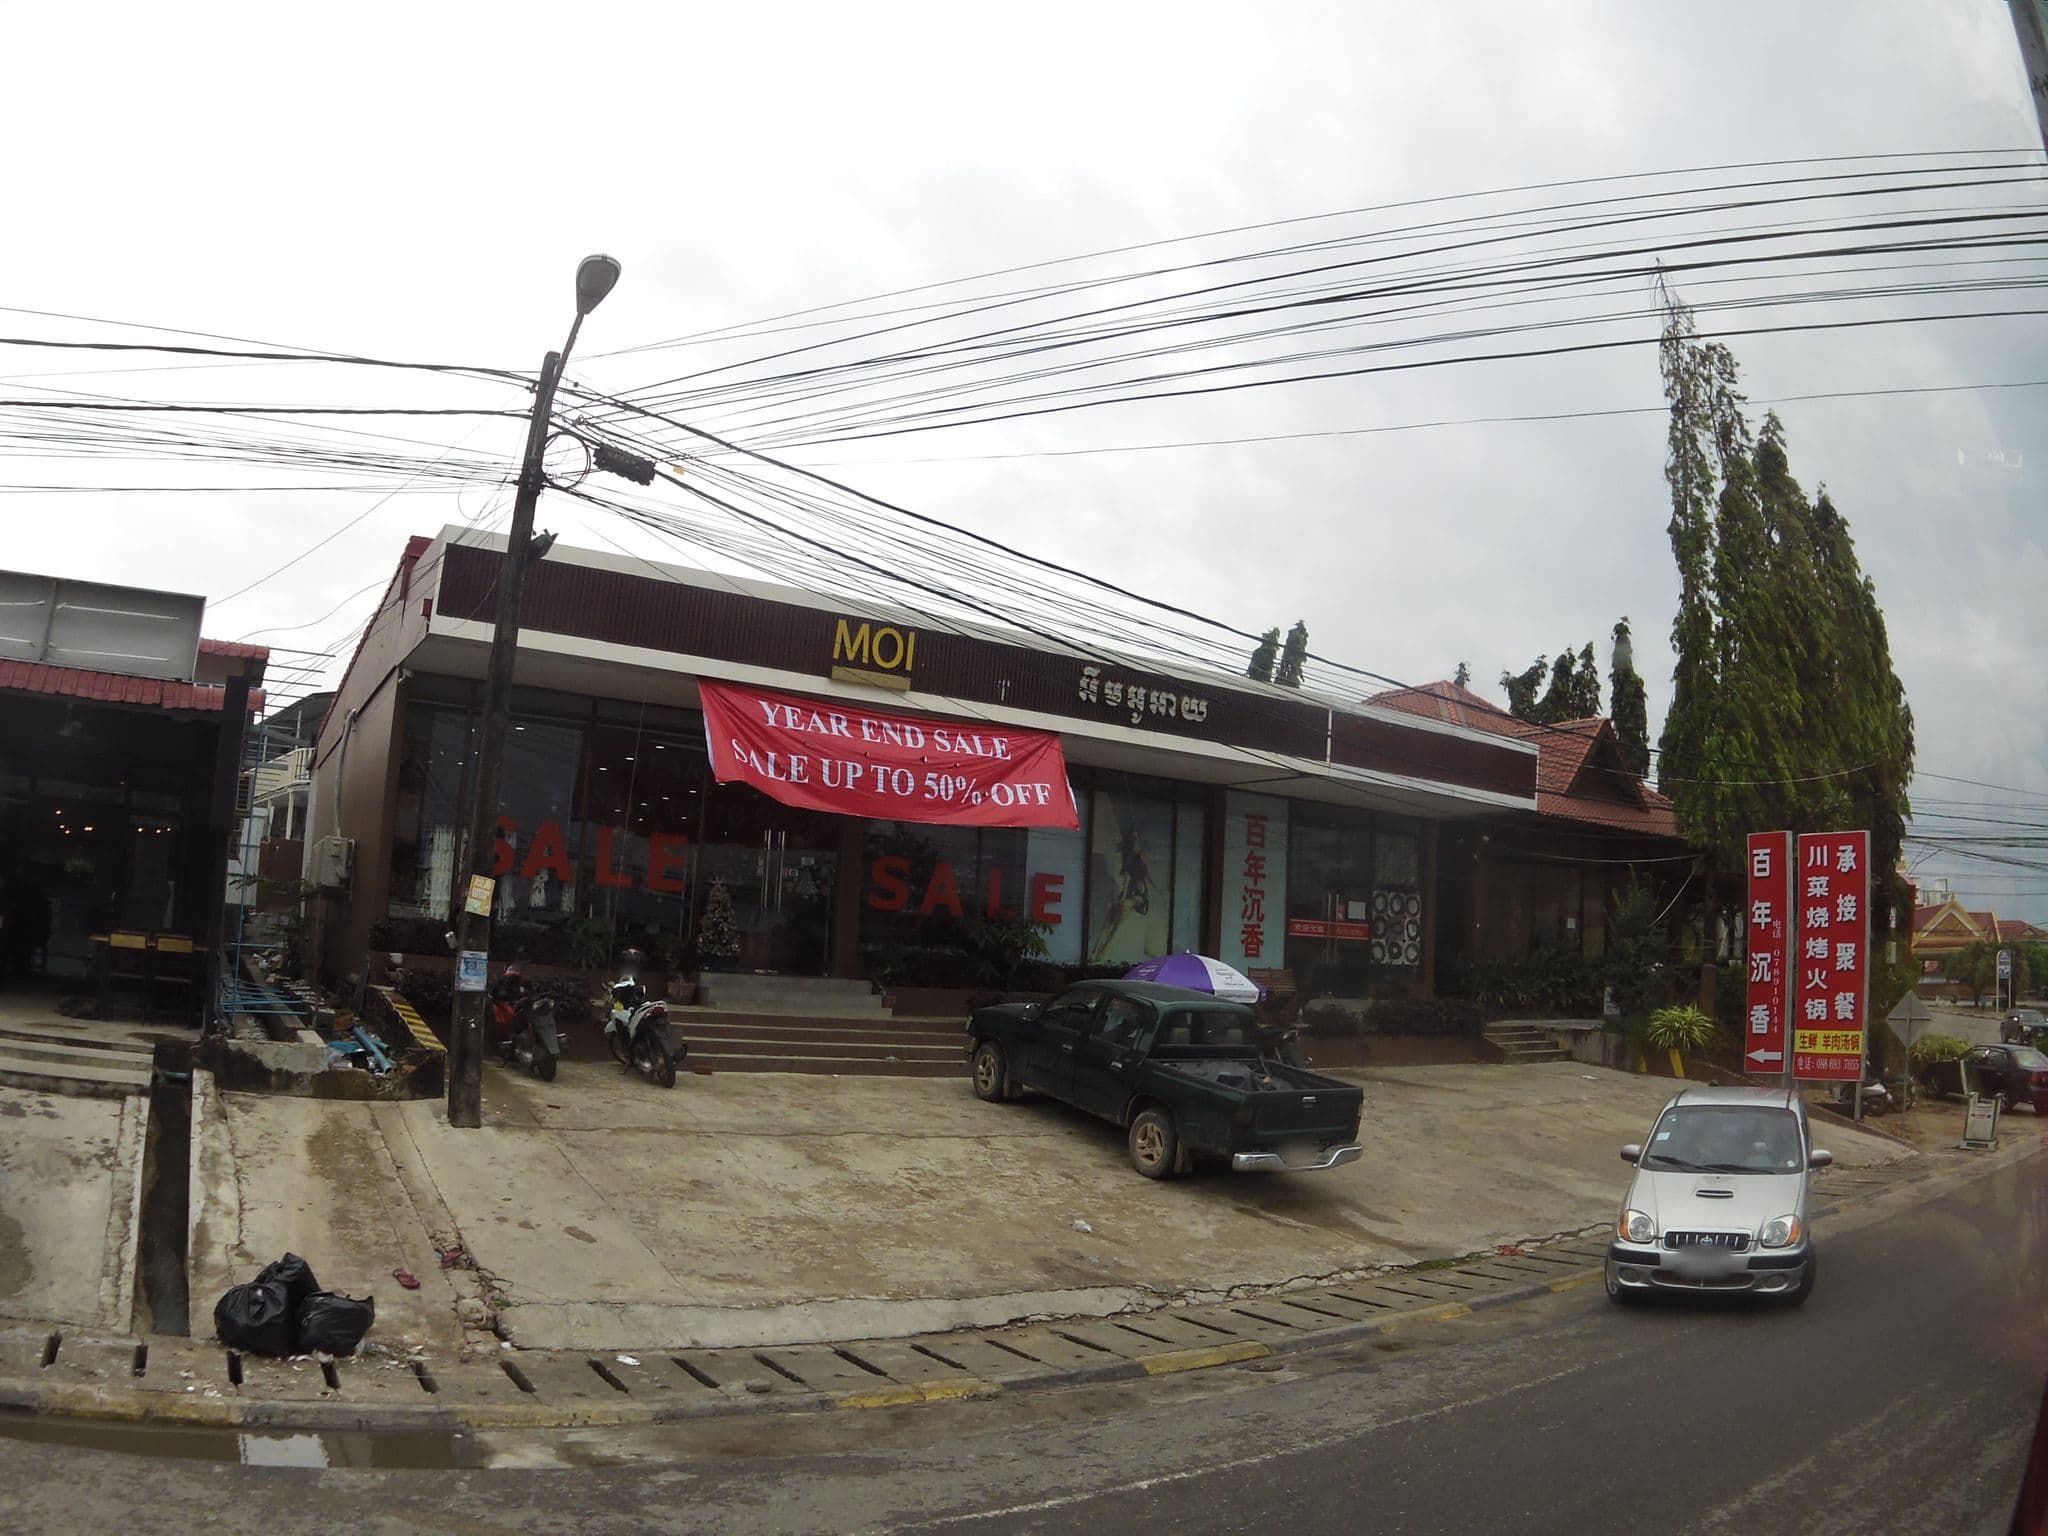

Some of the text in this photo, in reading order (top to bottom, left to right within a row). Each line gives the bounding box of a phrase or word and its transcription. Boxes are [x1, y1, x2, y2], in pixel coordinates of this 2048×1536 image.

[832, 618, 917, 672] MOI
[731, 738, 1052, 806] SALE UP TO 50% OFF
[757, 700, 1013, 761] YEAR END SALE
[868, 855, 1065, 925] SALE
[1241, 814, 1269, 959] 百年沉香
[1805, 844, 1830, 1021] 川菜烧烤火锅
[1834, 844, 1857, 1021] 承接聚餐
[1749, 848, 1772, 1035] 百年沉香
